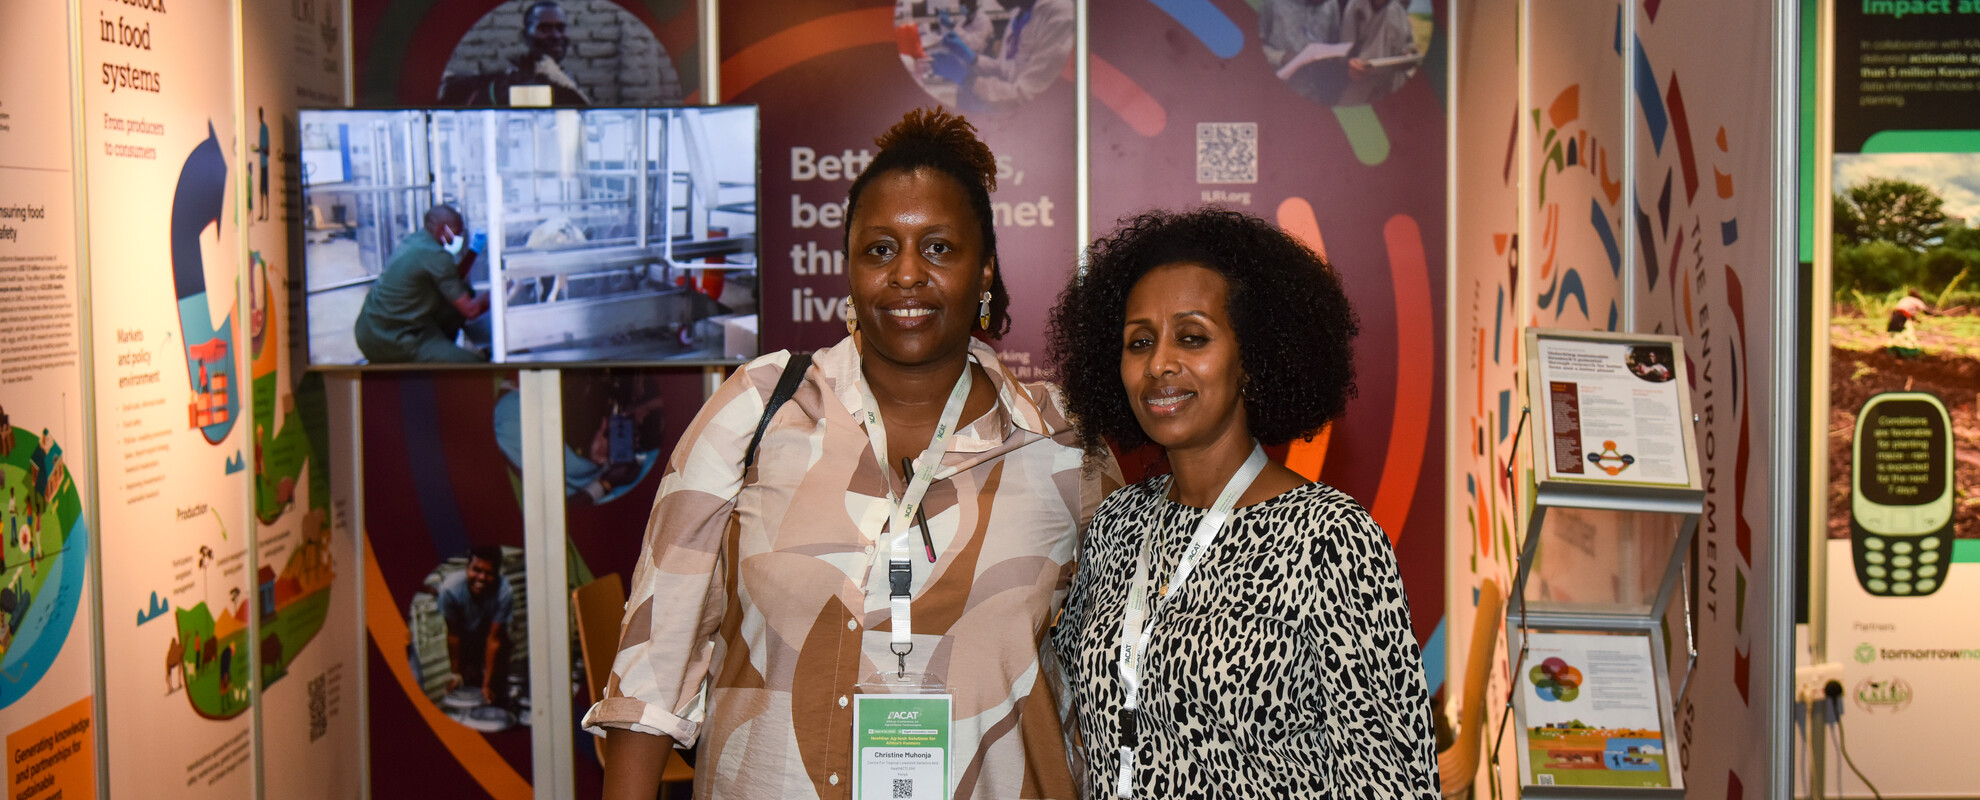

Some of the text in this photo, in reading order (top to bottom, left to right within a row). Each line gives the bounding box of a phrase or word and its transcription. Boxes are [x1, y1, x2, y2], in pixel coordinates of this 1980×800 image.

[1862, 0, 1951, 19] Impact
[100, 10, 151, 51] in food
[1909, 53, 1968, 64] actionable
[102, 61, 160, 93] systems
[1860, 67, 1887, 78] than
[1888, 66, 1897, 78] 5
[1898, 67, 1937, 78] million
[104, 112, 165, 136] From producers
[104, 142, 157, 160] to consumers
[27, 204, 45, 219] food
[117, 328, 144, 344] Markets
[118, 350, 152, 366] and policy
[119, 371, 160, 389] environment
[1690, 214, 1717, 622] THE ENVIRONMENT
[176, 502, 209, 522] Production
[1188, 542, 1201, 561] ACAT
[893, 711, 919, 719] ACAT
[14, 718, 90, 764] Generating knowledge
[15, 740, 82, 785] and partnerships for
[16, 773, 55, 800] sustainable
